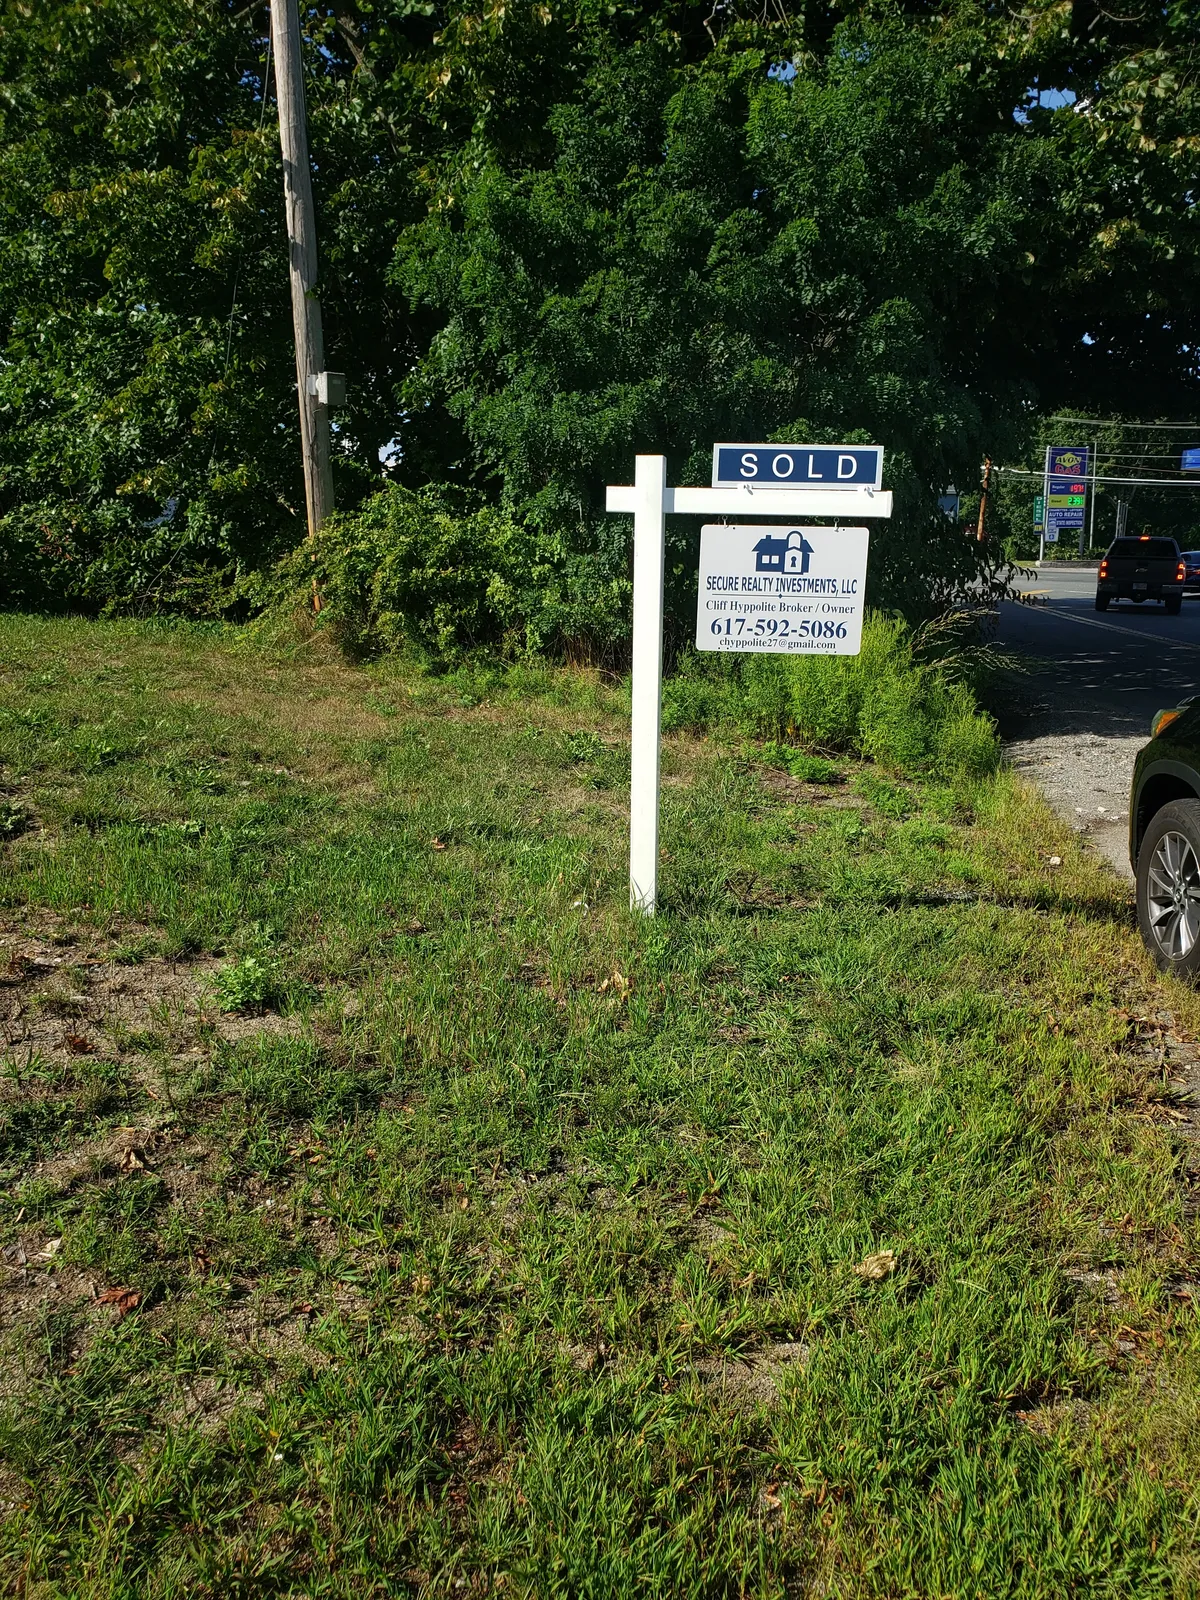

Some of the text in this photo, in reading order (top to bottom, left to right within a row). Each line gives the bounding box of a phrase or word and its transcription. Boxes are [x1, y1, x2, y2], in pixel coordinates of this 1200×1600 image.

[740, 453, 857, 479] SOLD
[1055, 464, 1081, 475] GAS
[706, 576, 857, 597] SECURE REALTY INVESTMENTS, LLC
[706, 600, 855, 614] Cliff Hyppolite Broker / Owner
[710, 617, 848, 639] 617-592-5086
[719, 637, 836, 650] chyppolite27@gmail.com
